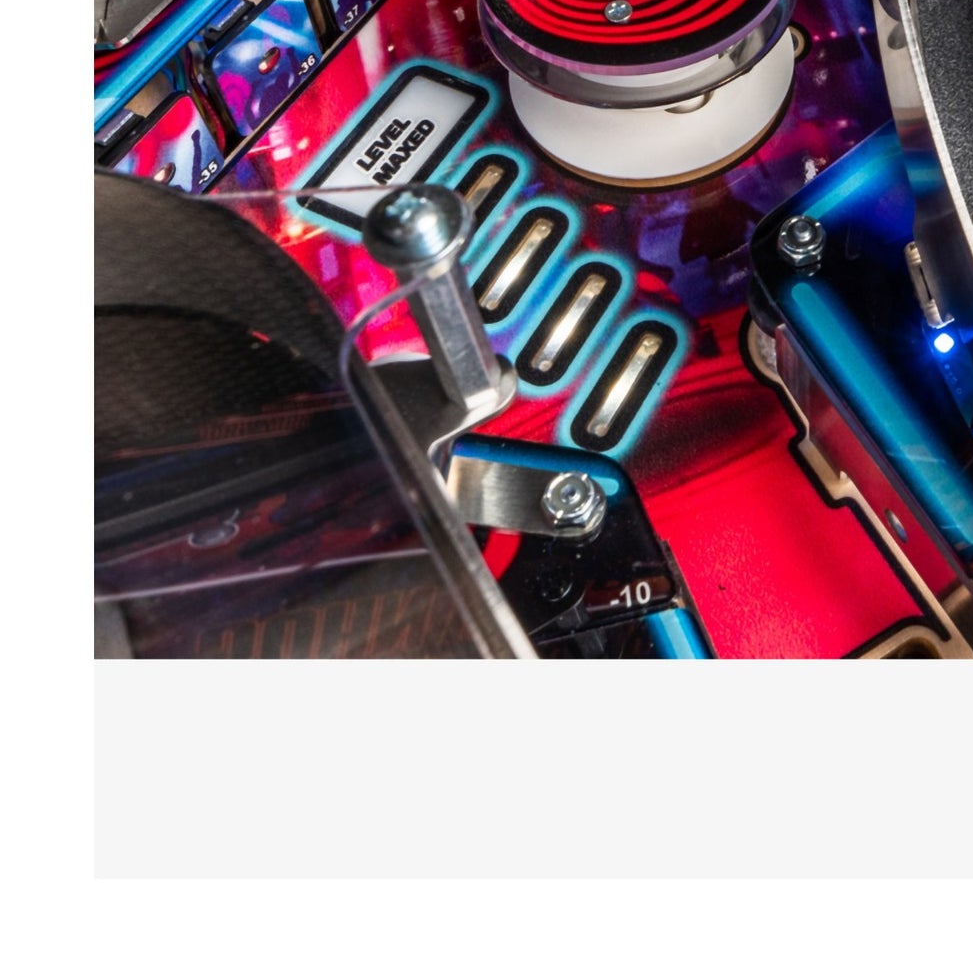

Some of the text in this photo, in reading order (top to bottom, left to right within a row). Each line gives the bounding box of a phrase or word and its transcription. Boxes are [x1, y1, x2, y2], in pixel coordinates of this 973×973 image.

[343, 4, 360, 26] -37
[298, 54, 317, 76] -36
[355, 117, 412, 172] LEVEL
[371, 118, 436, 186] MAXED
[198, 161, 219, 185] -35
[610, 581, 651, 608] -10
